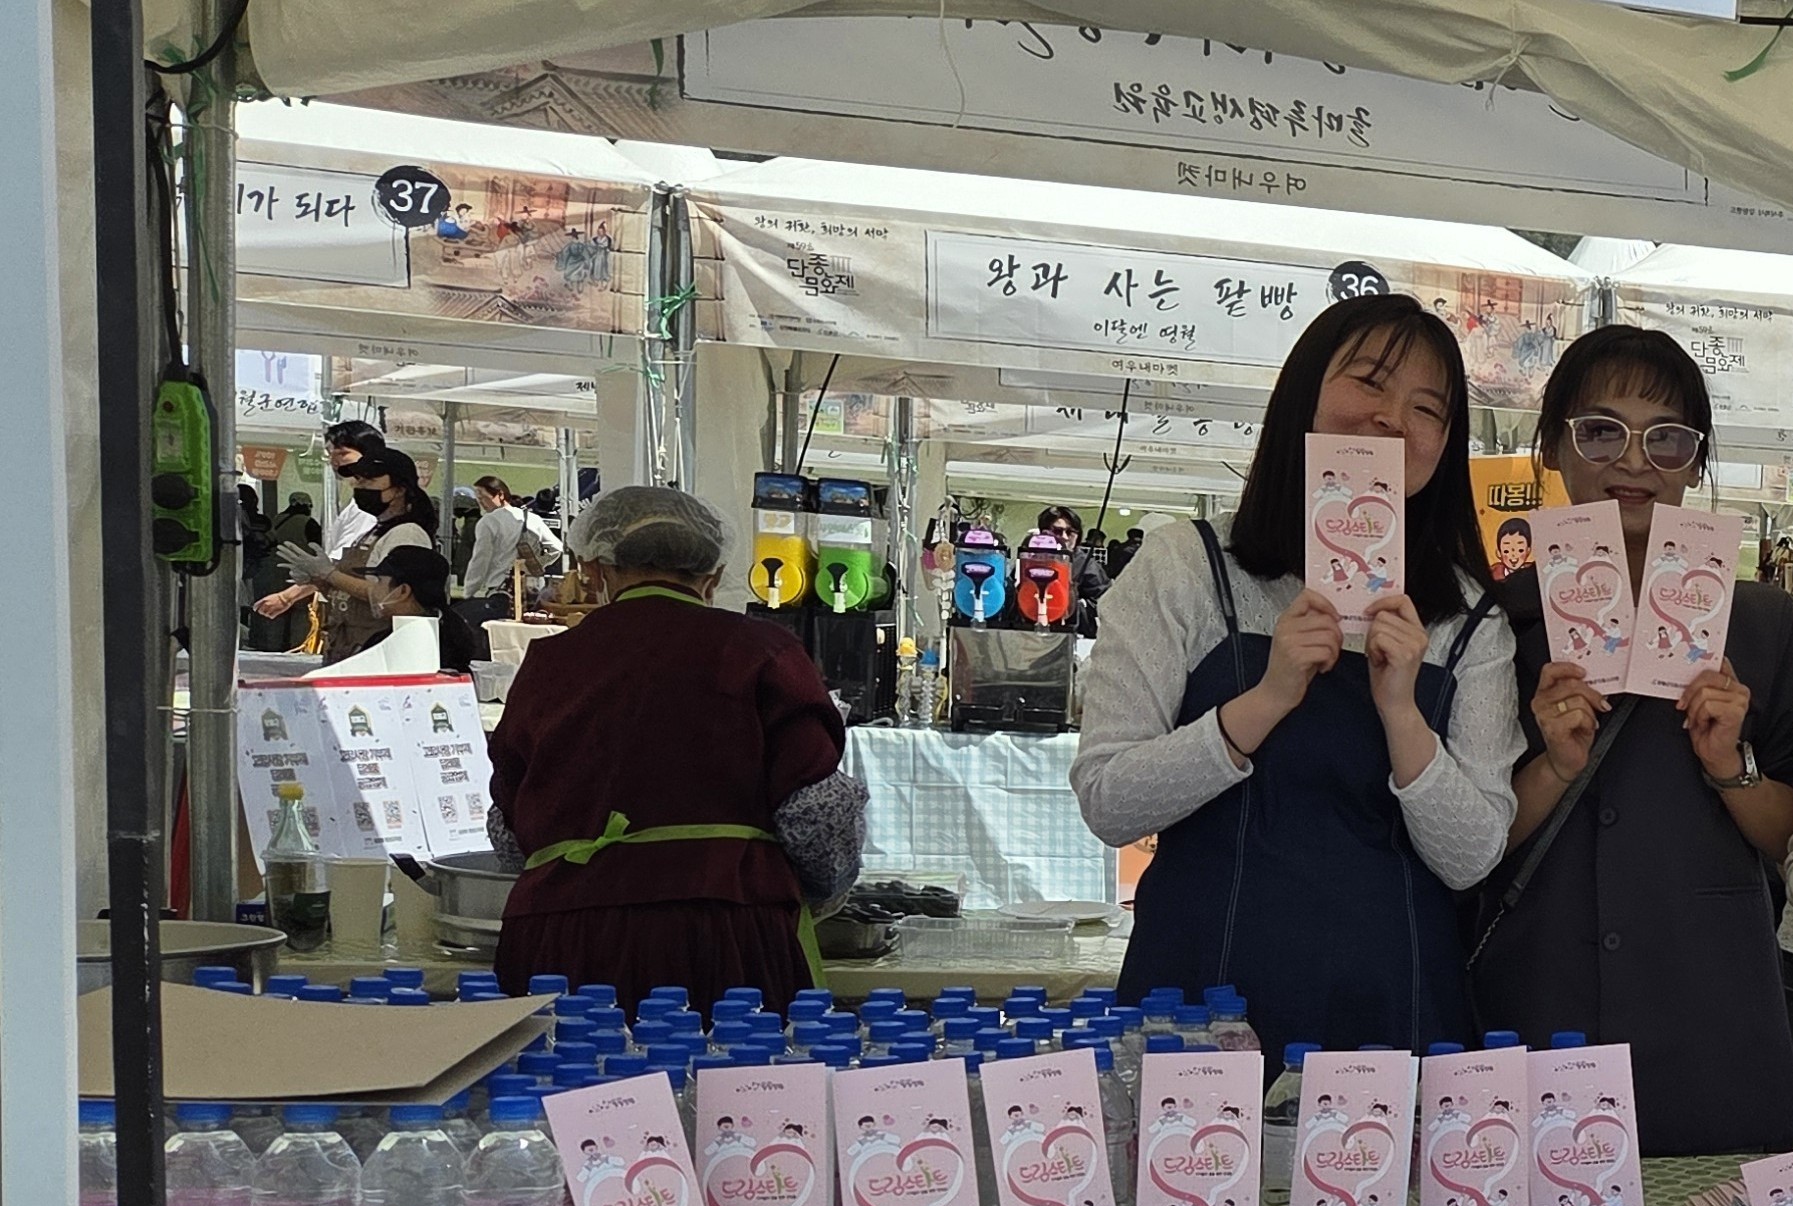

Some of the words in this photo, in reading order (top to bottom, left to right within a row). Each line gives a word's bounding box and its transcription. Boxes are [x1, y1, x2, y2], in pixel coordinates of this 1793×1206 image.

[236, 182, 280, 221] 가
[294, 191, 356, 228] 되다
[388, 178, 440, 214] 37
[986, 254, 1070, 299] 왕과
[1103, 267, 1181, 313] 사는
[1213, 276, 1299, 322] 팥빵
[1338, 272, 1381, 300] 36
[1110, 357, 1180, 376] 여우내마켓
